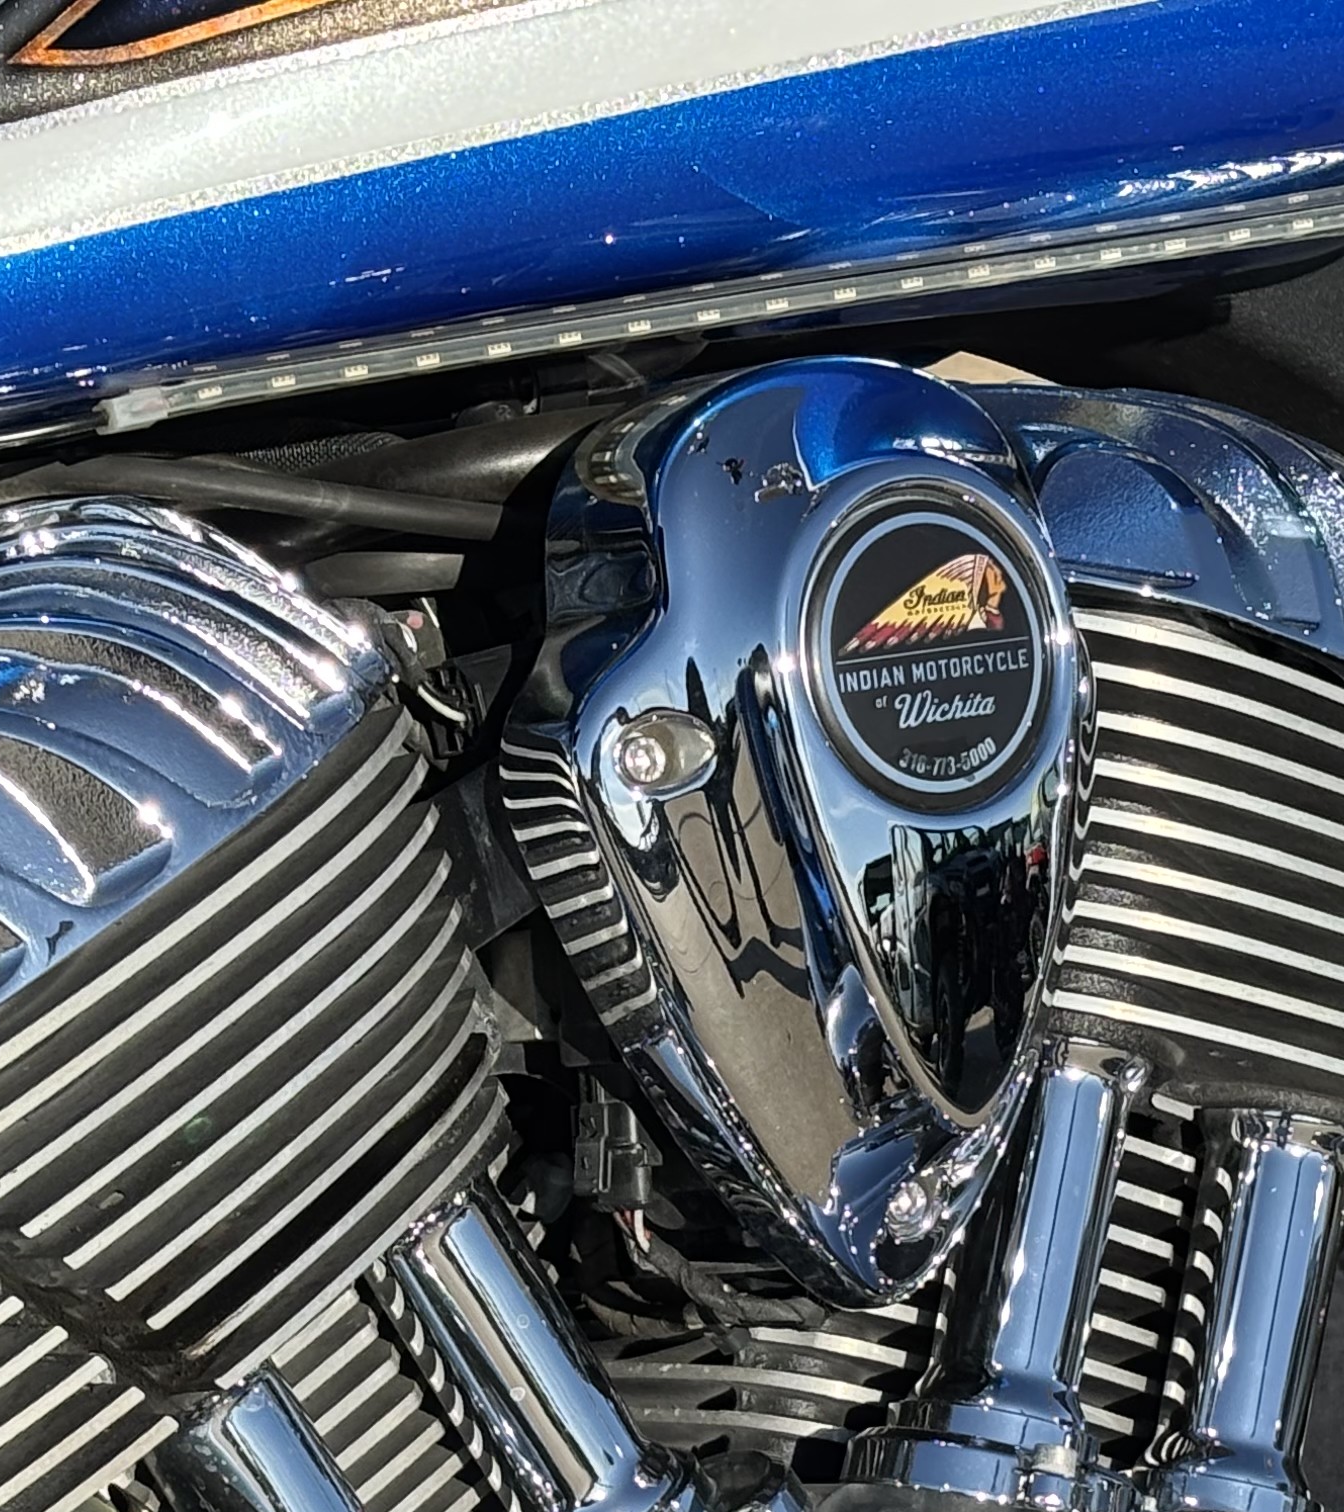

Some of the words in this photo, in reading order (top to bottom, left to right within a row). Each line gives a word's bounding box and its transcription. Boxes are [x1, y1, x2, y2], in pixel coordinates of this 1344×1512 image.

[903, 585, 967, 610] Indian
[839, 665, 905, 693] INDIAN
[912, 649, 1030, 684] MOTORCYCLE
[875, 695, 888, 709] of
[894, 690, 996, 729] Wichita
[898, 737, 997, 776] 316-773-5000
